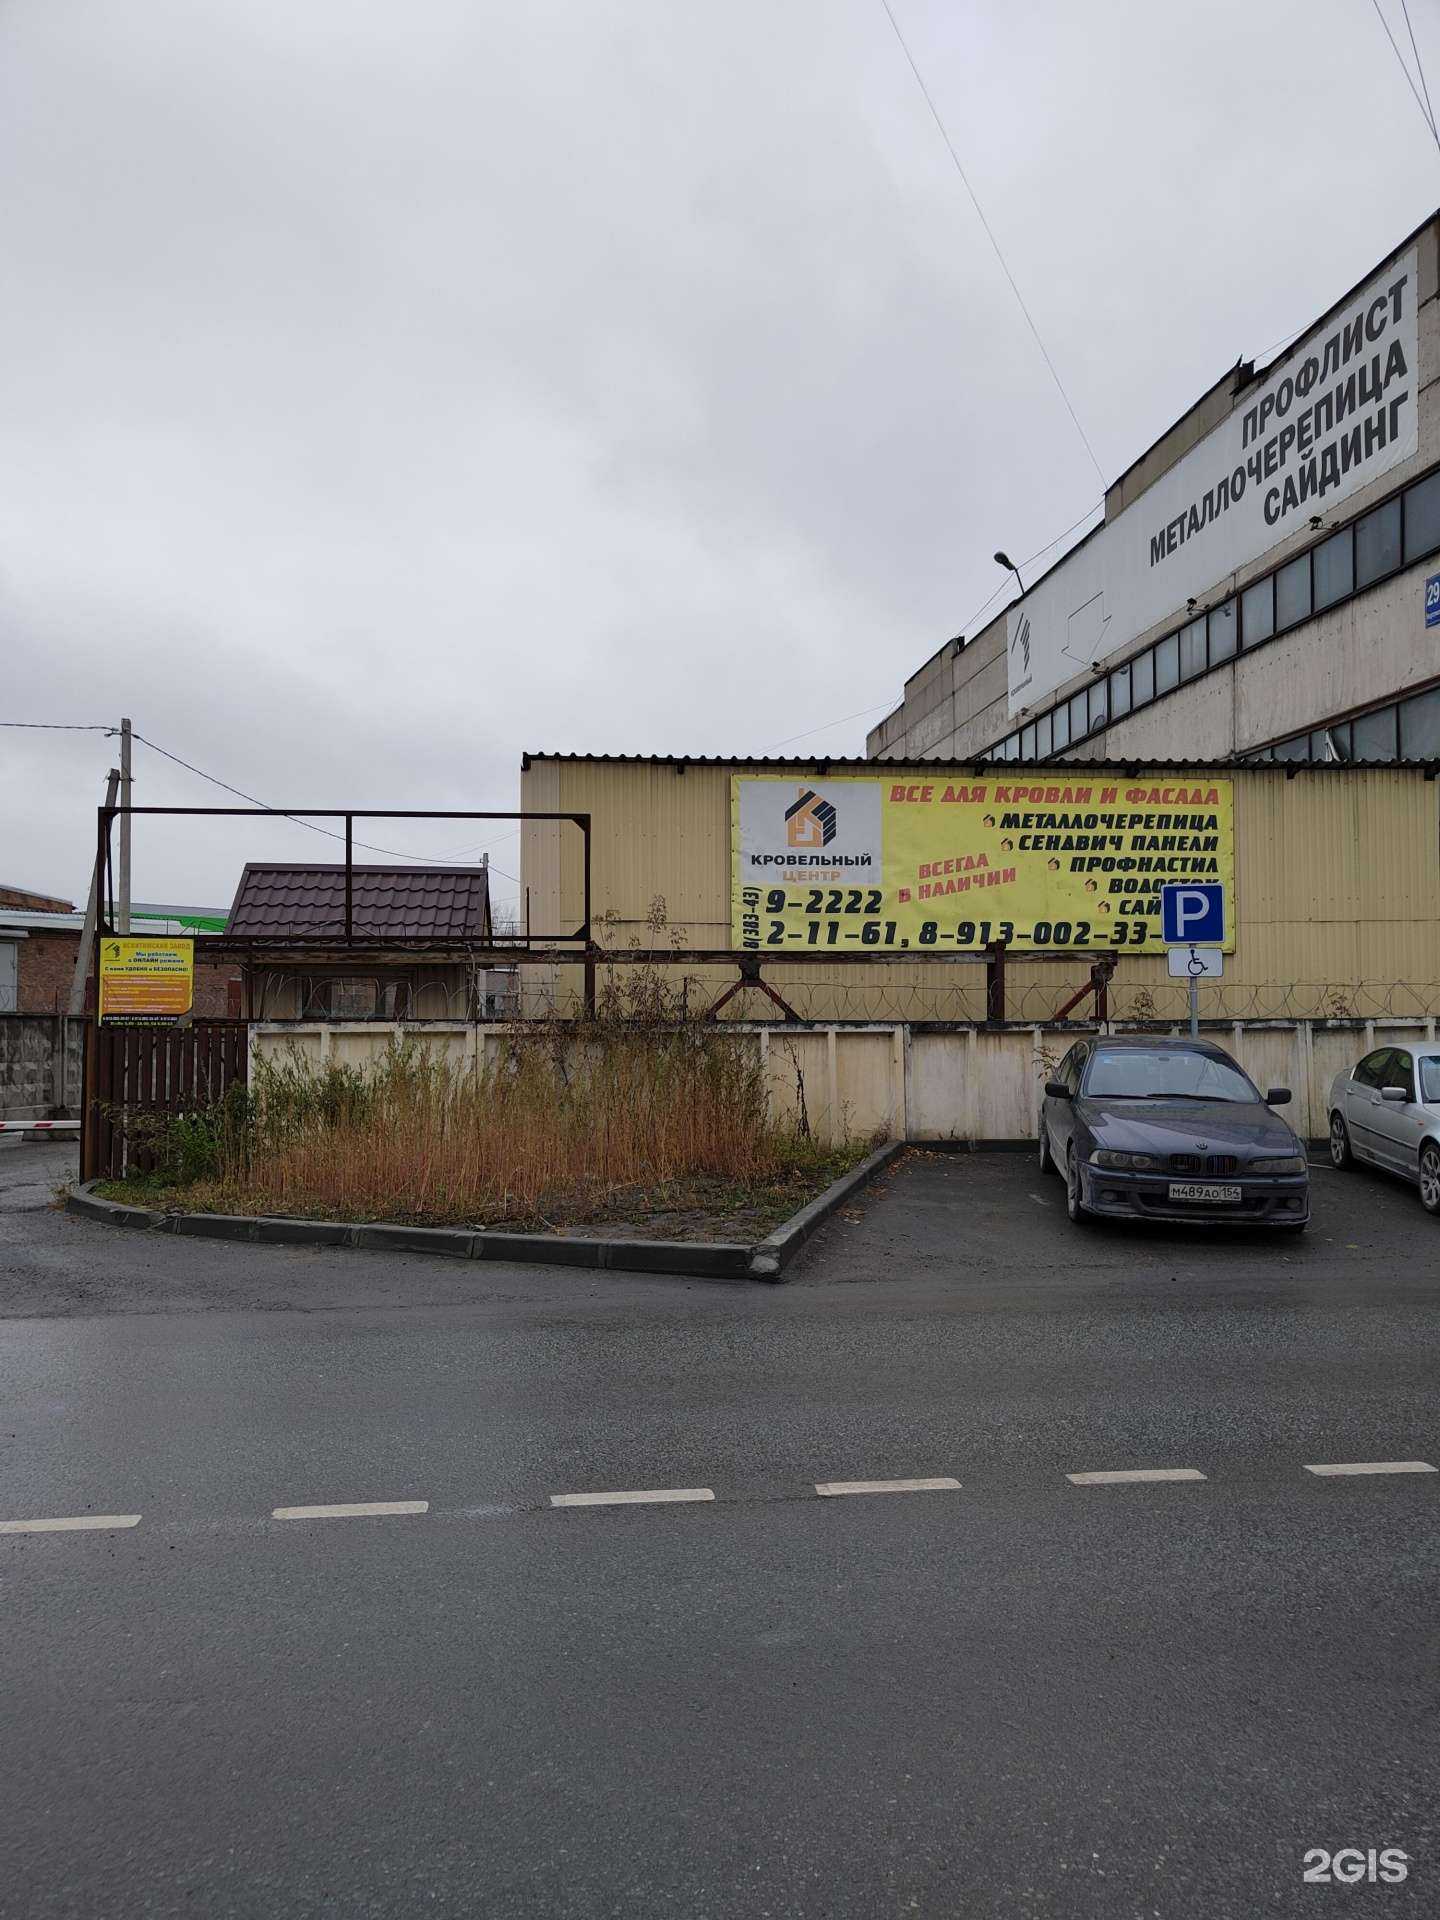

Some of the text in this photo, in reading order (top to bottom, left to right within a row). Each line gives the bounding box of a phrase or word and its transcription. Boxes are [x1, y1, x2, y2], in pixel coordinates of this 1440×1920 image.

[1241, 274, 1408, 449] ПРОФЛИСТ
[1150, 338, 1408, 567] МЕТАЛЛОЧЕРЕПИЦА
[1264, 391, 1408, 525] САЙДИНГ
[890, 784, 1220, 805] ВСЕ ДЛЯ КРОВЛИ И ФАСАДА
[1000, 813, 1218, 831] МЕТАЛЛОЧЕРЕПИЦА
[1019, 834, 1219, 852] СЕНДВИЧ ПАНЕЛИ
[750, 853, 872, 866] КРОВЕЛЬНЫЙ
[918, 853, 989, 879] ВСЕГДА
[1069, 856, 1219, 873] ПРОФНАСТИЛ
[782, 870, 841, 882] ЦЕНТР
[898, 867, 1017, 903] В НАЛИЧИИ
[766, 889, 883, 913] 9-2222
[1118, 896, 1162, 915] САЙ
[742, 887, 763, 949] 8(383-43)
[1176, 891, 1210, 937] P
[918, 921, 1163, 945] 8-913-002-33-
